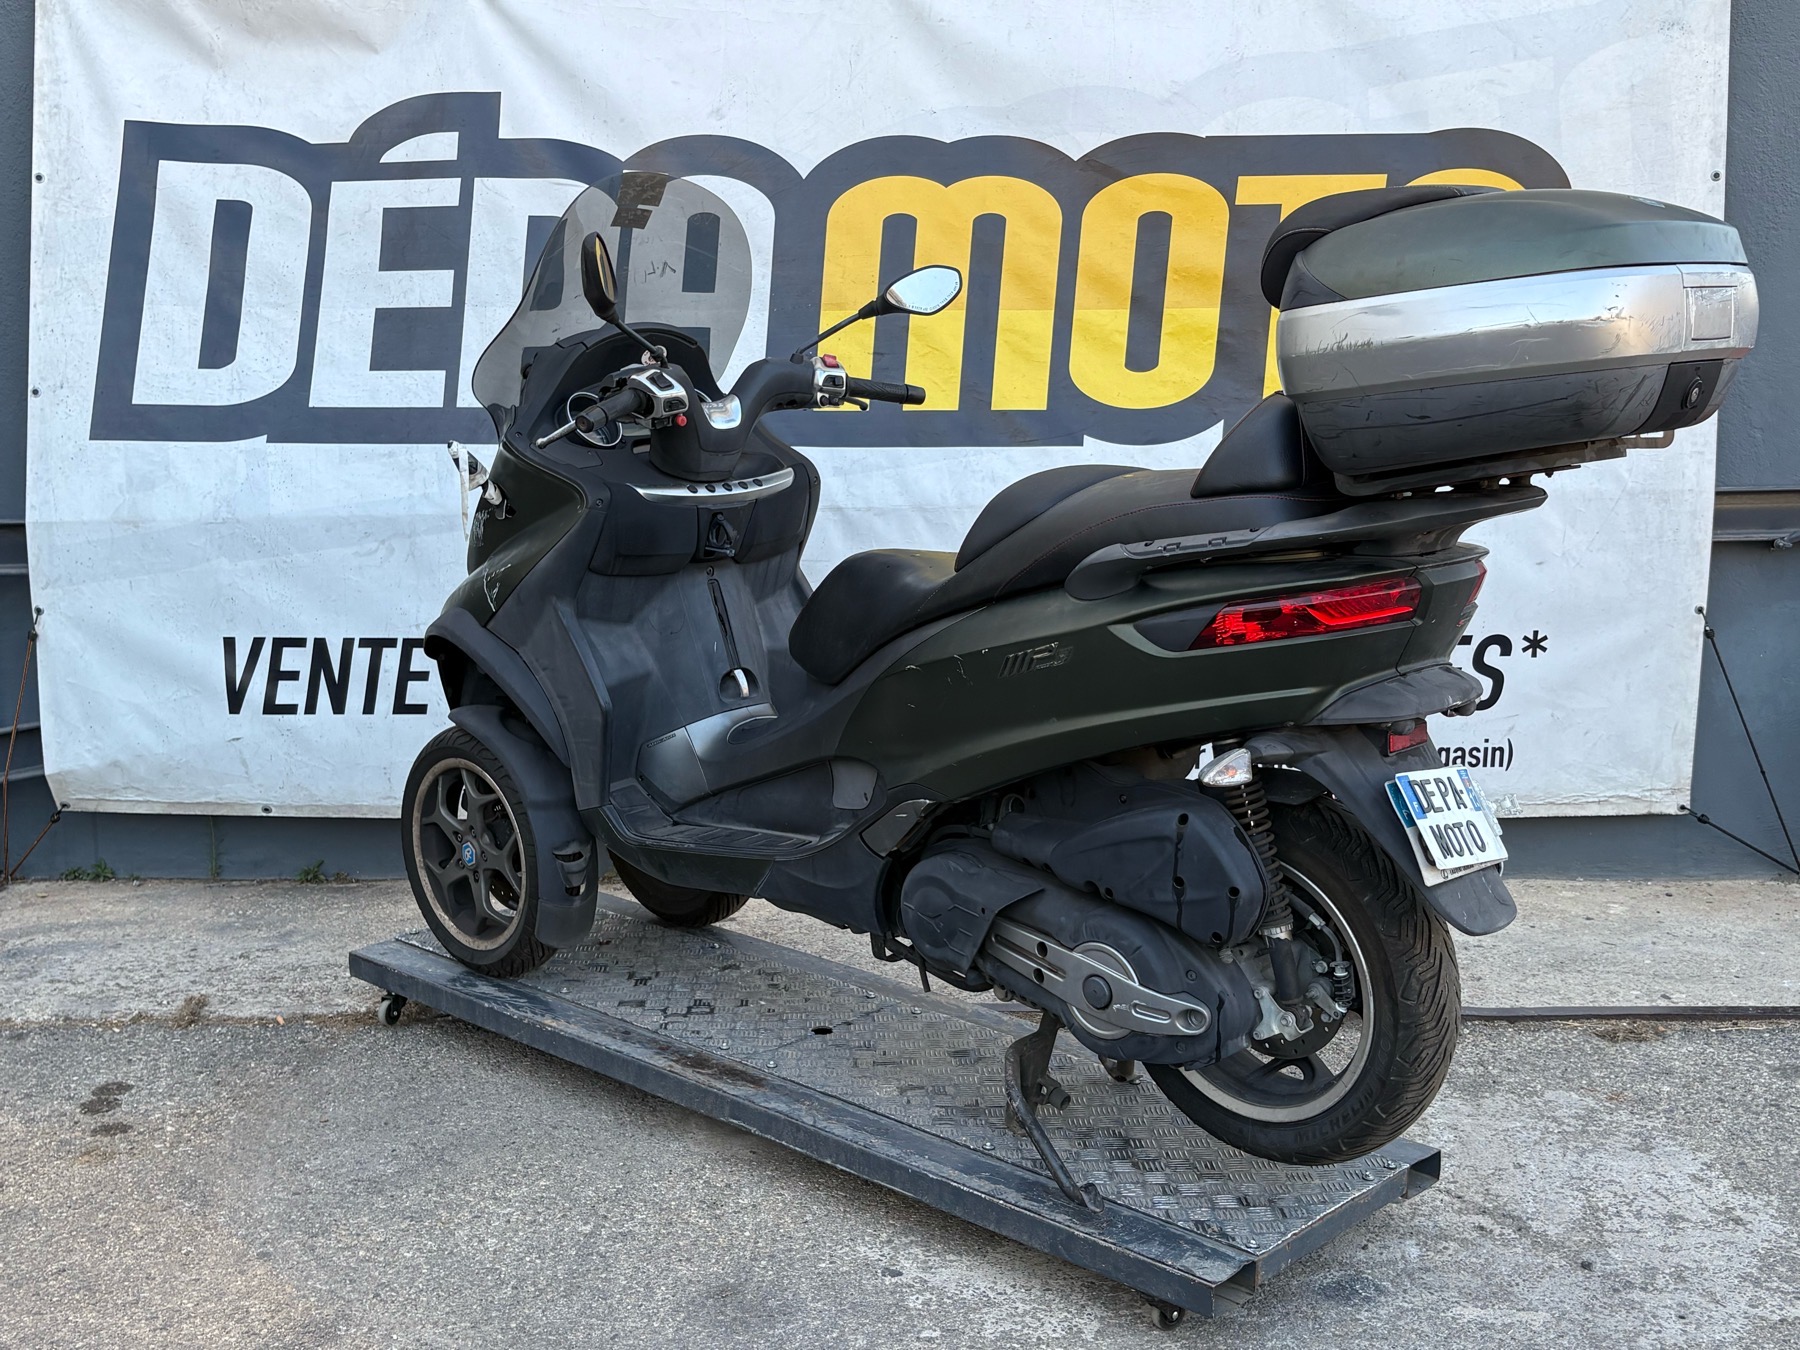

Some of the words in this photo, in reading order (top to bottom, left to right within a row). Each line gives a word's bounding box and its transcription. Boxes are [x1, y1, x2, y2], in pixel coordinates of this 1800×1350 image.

[819, 168, 1525, 411] MOT
[223, 637, 430, 715] VENTE
[1428, 820, 1486, 859] MOTO
